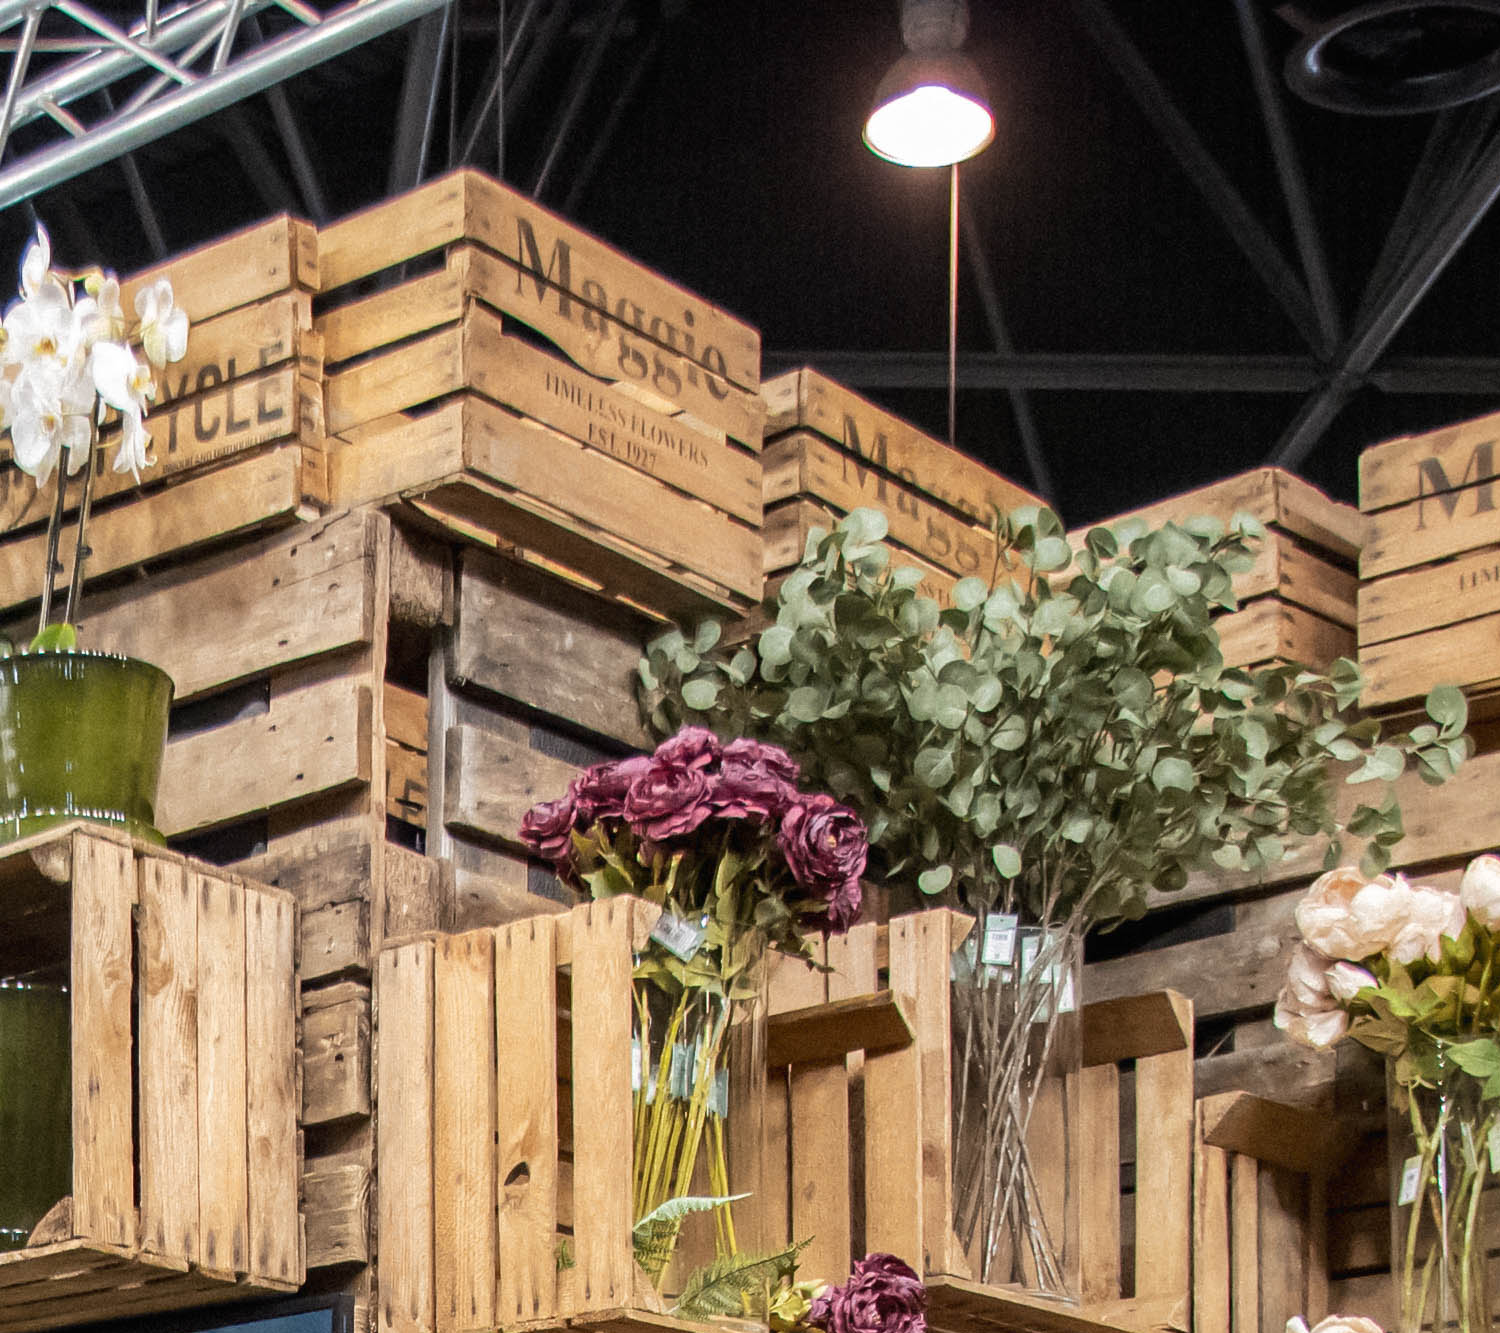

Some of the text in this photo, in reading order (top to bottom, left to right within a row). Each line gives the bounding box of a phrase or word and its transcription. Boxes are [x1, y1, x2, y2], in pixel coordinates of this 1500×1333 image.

[515, 216, 730, 400] Maggie
[546, 371, 709, 468] TIMELESS FLOWERS
